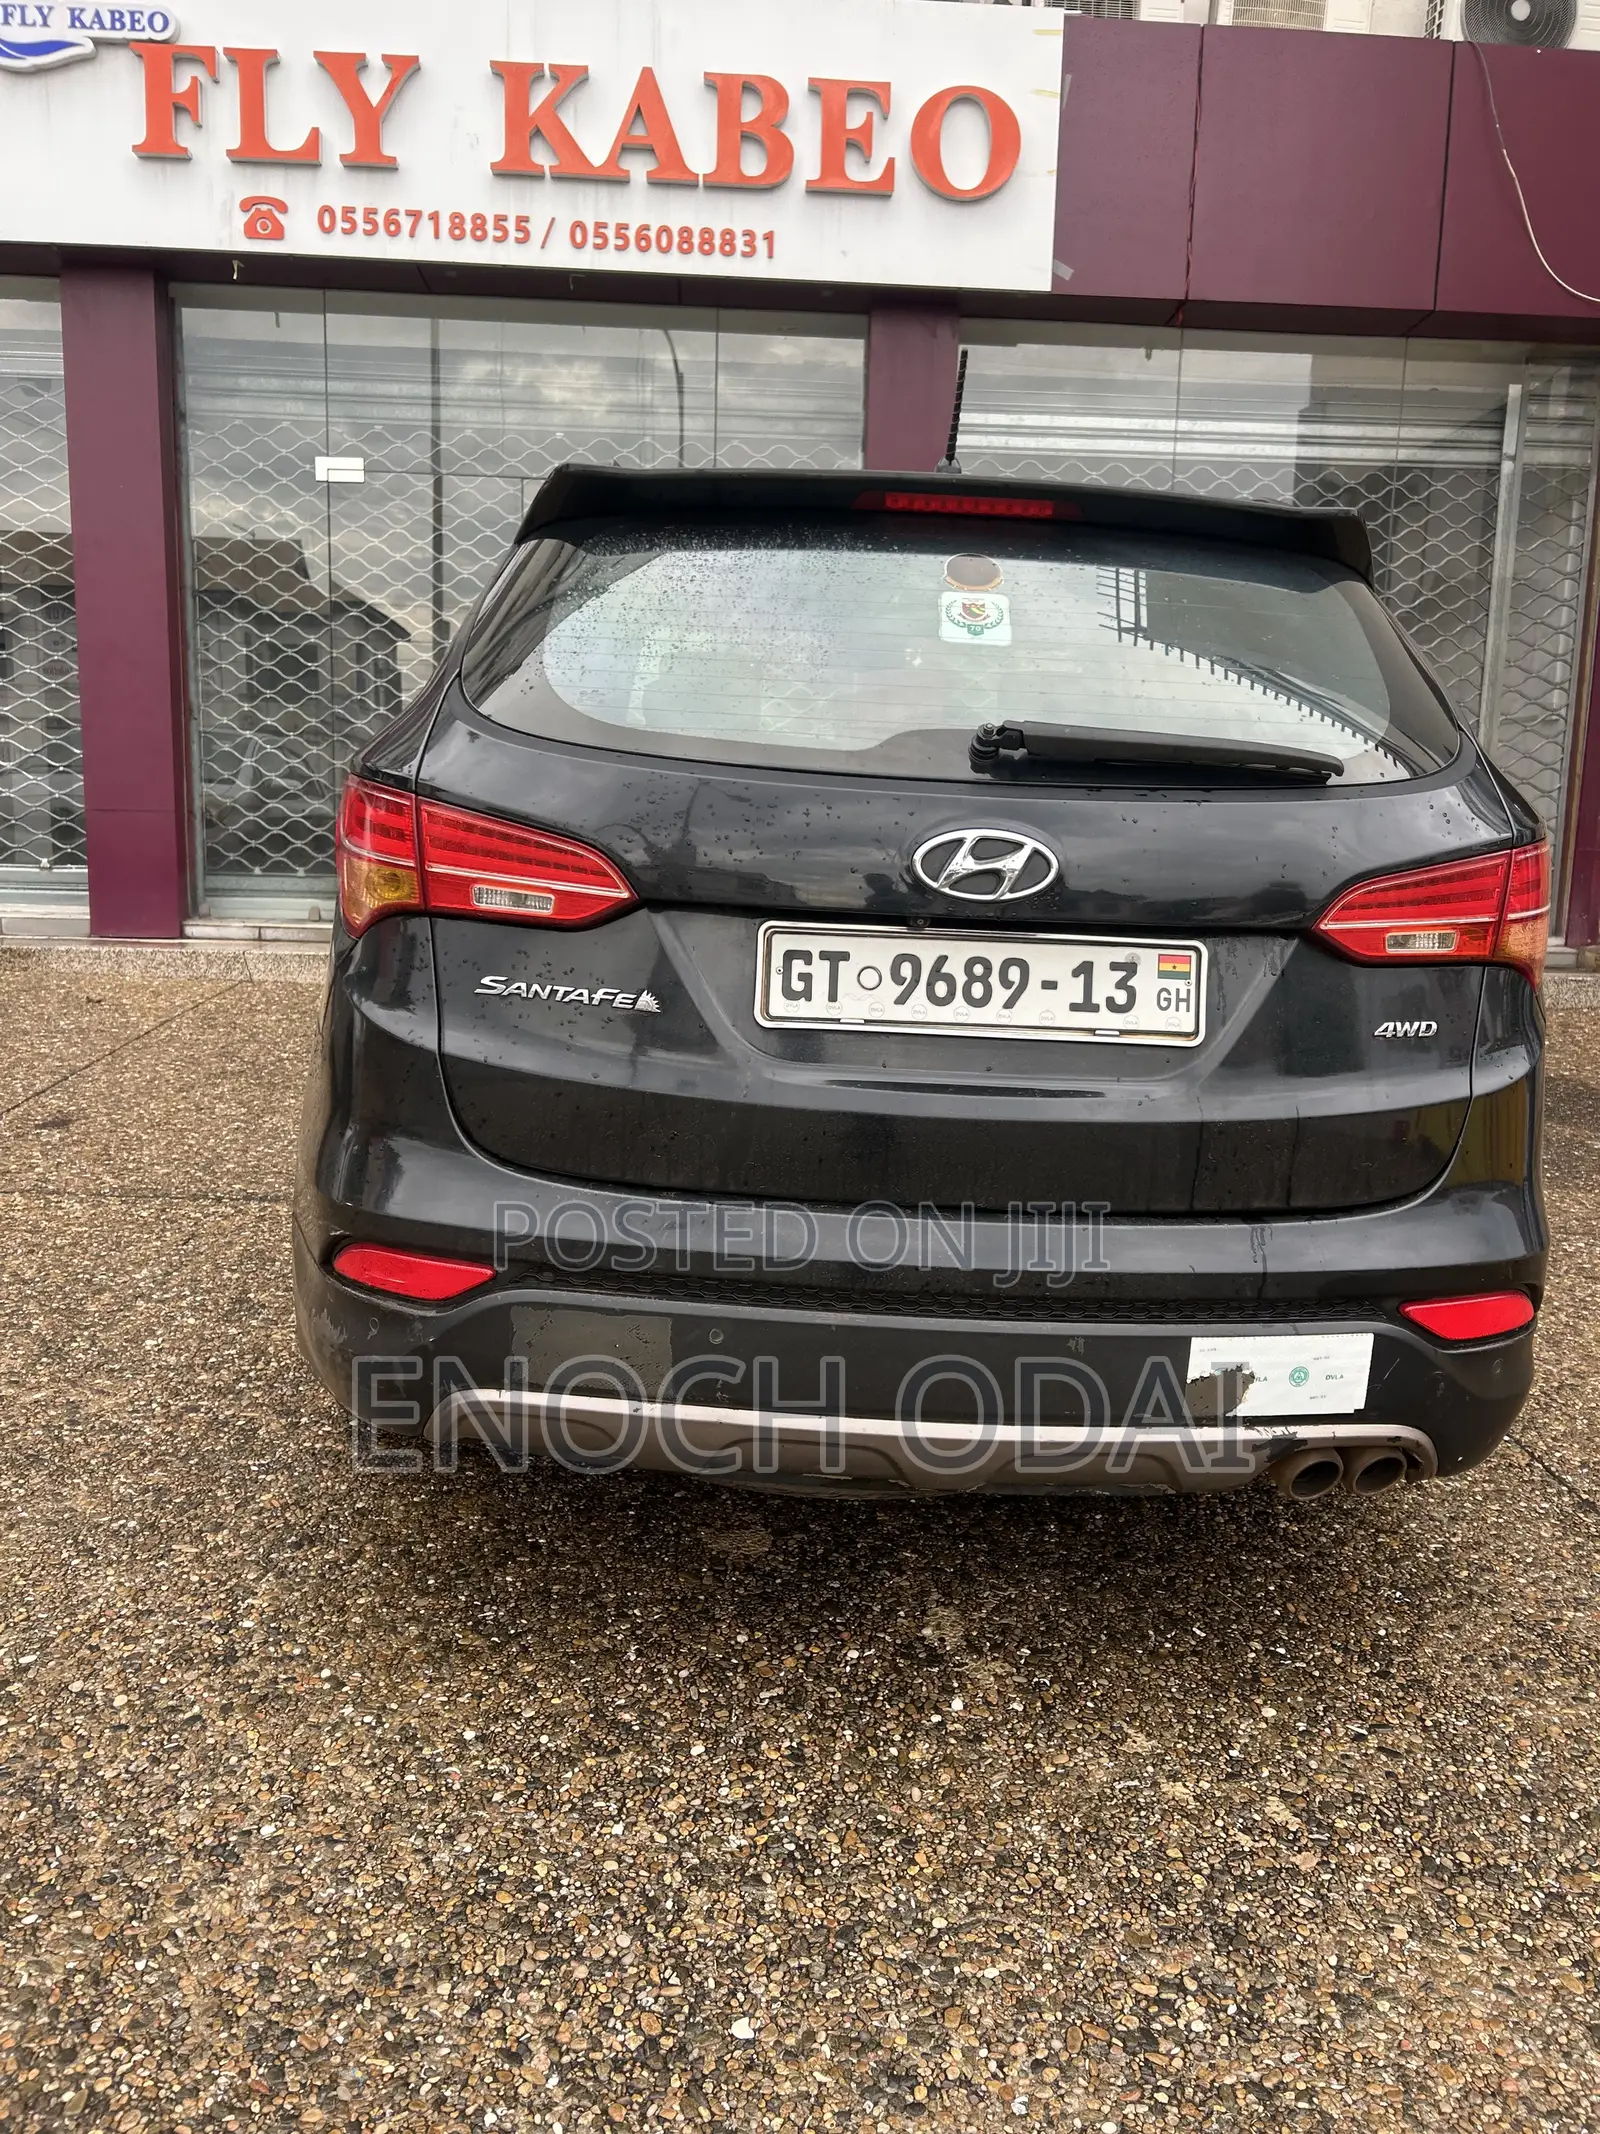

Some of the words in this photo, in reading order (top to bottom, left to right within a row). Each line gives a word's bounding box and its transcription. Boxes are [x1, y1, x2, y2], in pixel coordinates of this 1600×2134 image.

[0, 3, 54, 28] FLY
[67, 6, 170, 34] KABEO
[129, 41, 421, 170] FLY
[489, 59, 1021, 201] KABEO
[316, 204, 531, 244] 0556718855
[569, 219, 776, 259] 0556088831
[780, 949, 850, 1003] GT
[1156, 986, 1191, 1013] GH
[1373, 1020, 1438, 1038] 4WD
